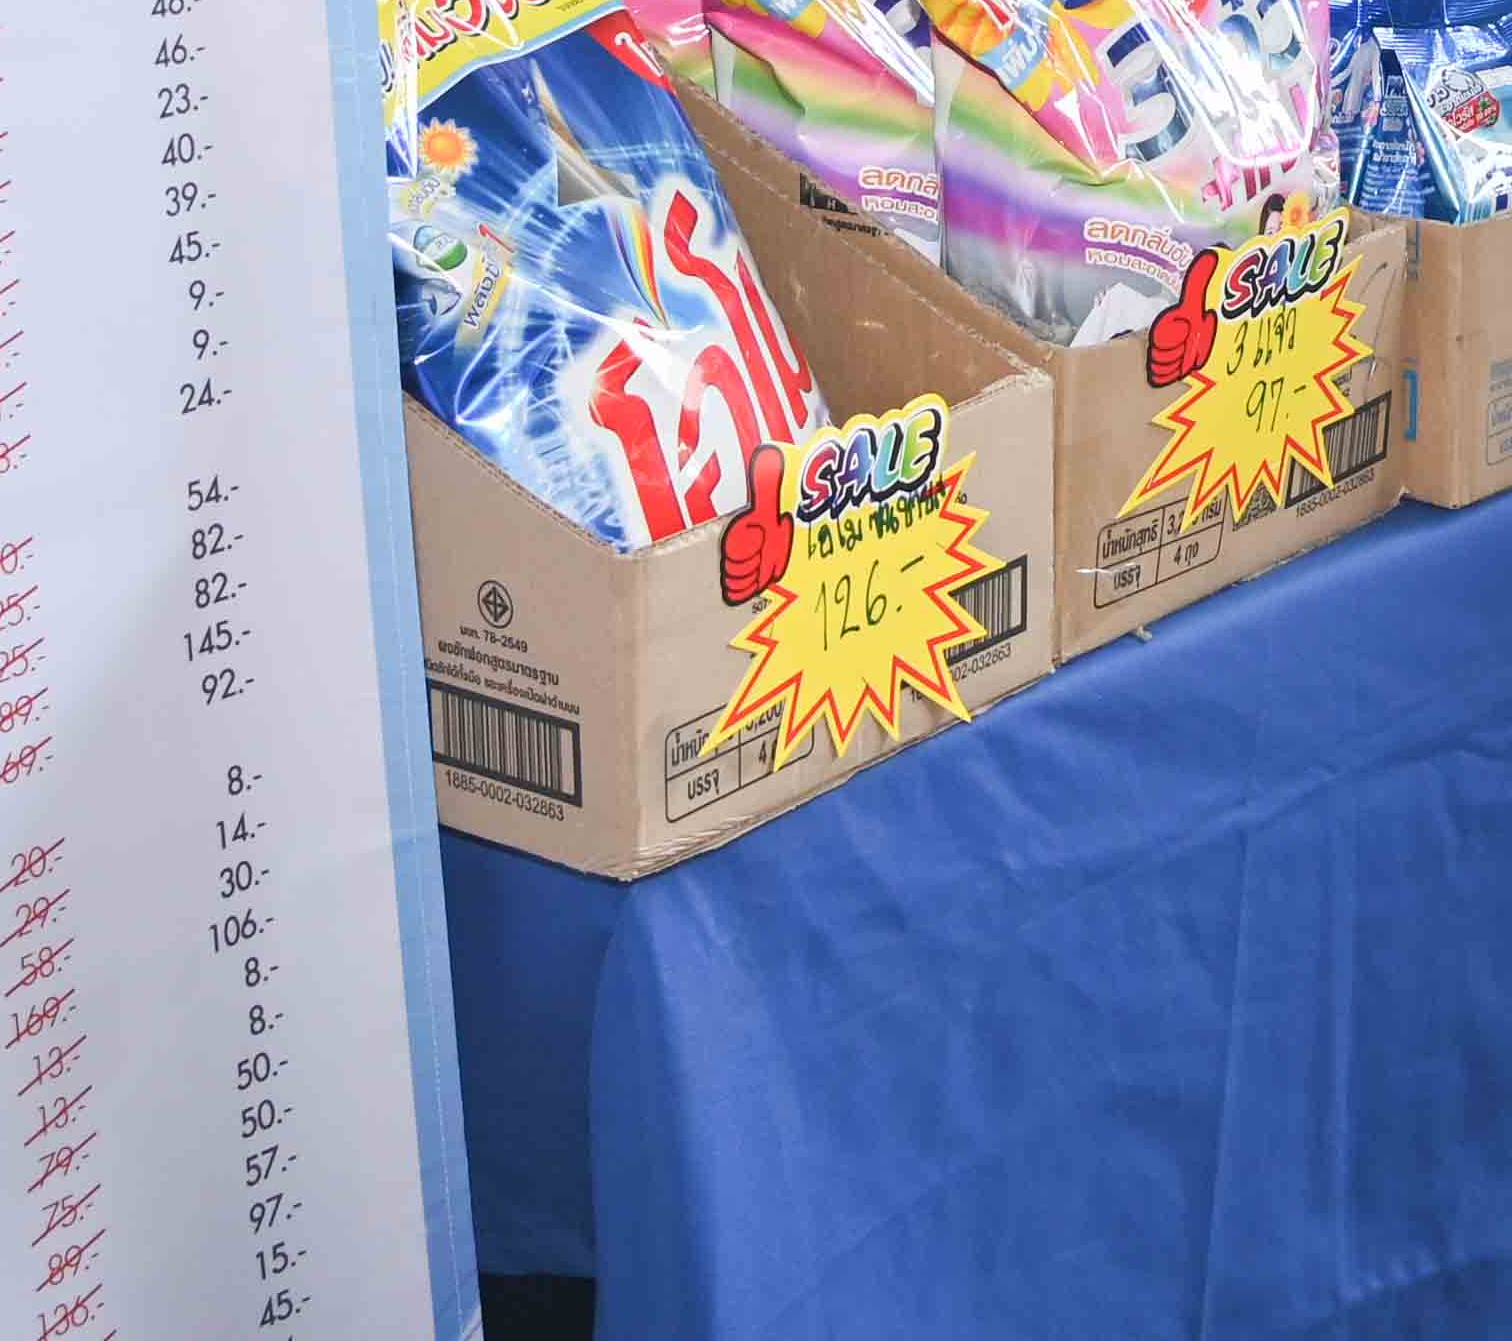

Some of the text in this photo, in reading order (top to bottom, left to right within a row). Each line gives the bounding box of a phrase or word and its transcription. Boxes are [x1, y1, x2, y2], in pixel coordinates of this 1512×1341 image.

[165, 182, 216, 215] 39.-
[1221, 219, 1343, 320] SALE
[188, 279, 225, 311] 9.-
[1246, 376, 1308, 433] 97.-
[796, 408, 943, 523] SALE
[188, 479, 240, 511] 54.-
[814, 554, 925, 652] 126.-
[183, 622, 251, 661] 145.-
[227, 764, 262, 795] 8.-
[444, 767, 565, 822] 1885-0002-032863
[687, 767, 720, 799] บรรจุ
[208, 911, 275, 953] 106.-
[249, 1197, 303, 1233] 97.-
[258, 1293, 311, 1328] 45.-
